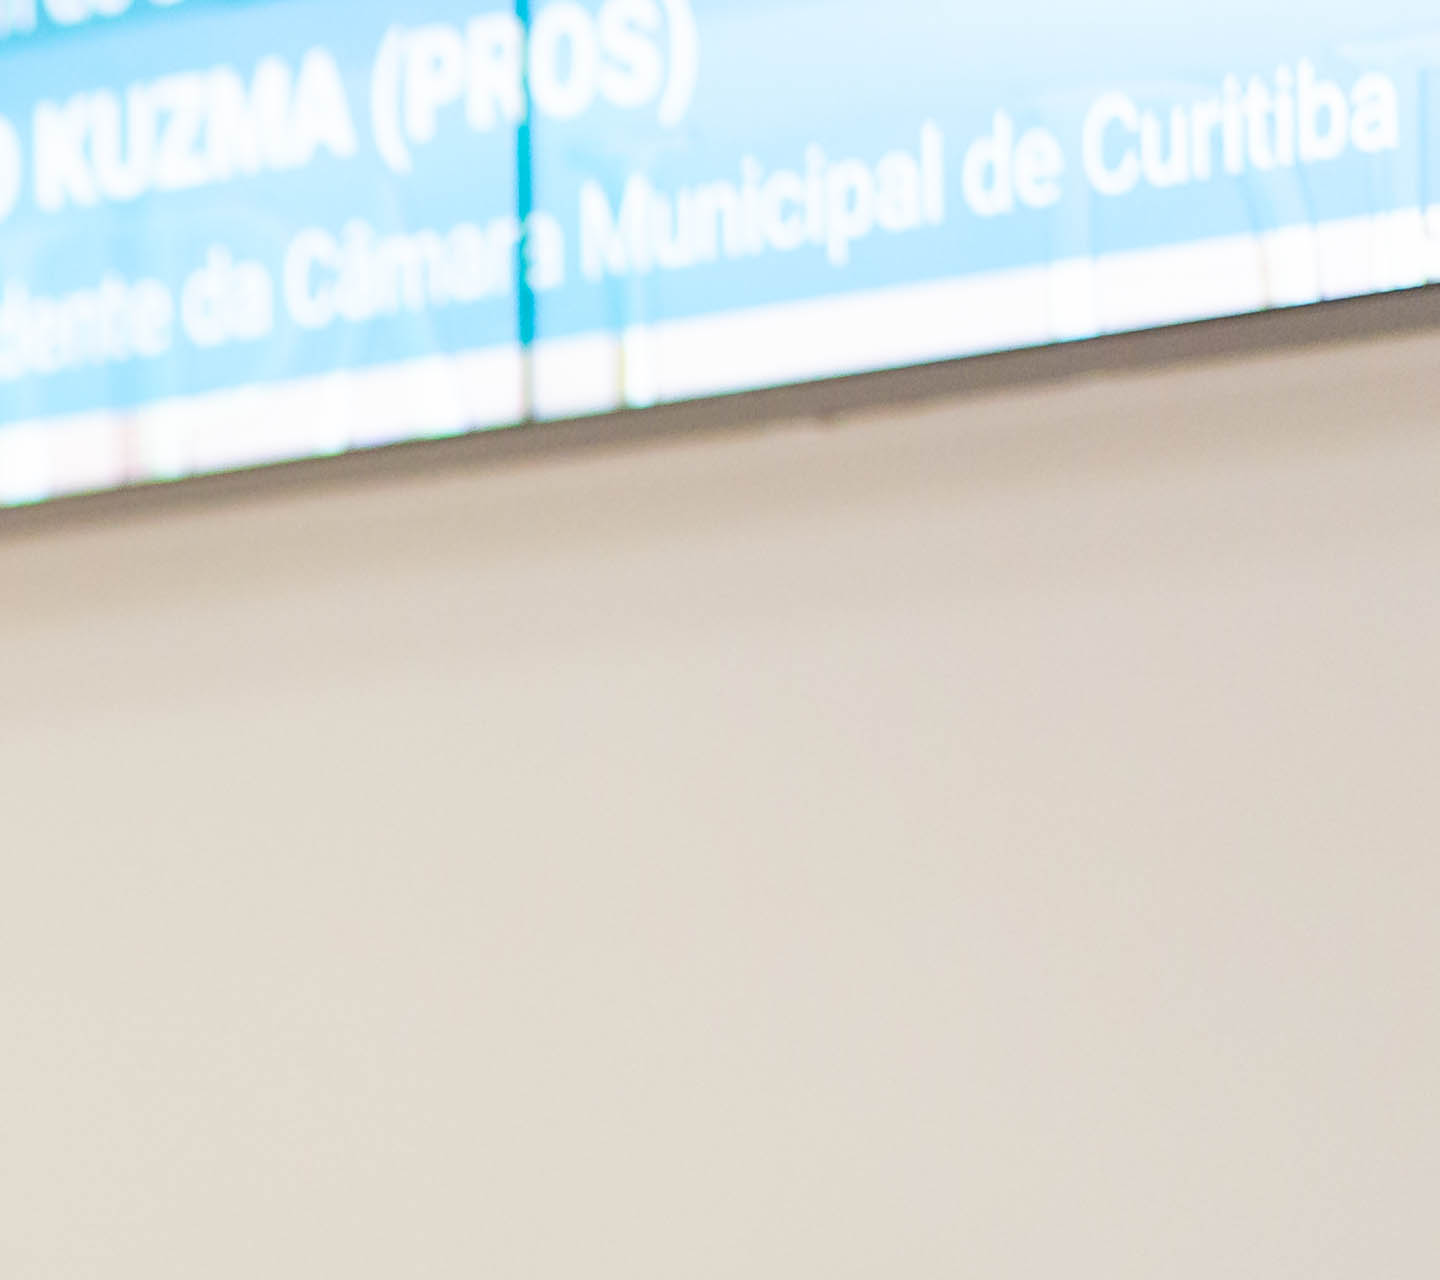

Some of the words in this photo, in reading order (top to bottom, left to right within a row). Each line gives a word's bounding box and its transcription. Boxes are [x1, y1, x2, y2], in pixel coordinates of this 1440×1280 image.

[32, 47, 357, 211] KUZMA
[370, 0, 699, 173] (PROS)
[180, 244, 273, 347] da
[284, 213, 566, 329] Câmara
[580, 118, 944, 267] Municipal
[962, 107, 1065, 216] de
[1083, 56, 1400, 196] Curitiba
